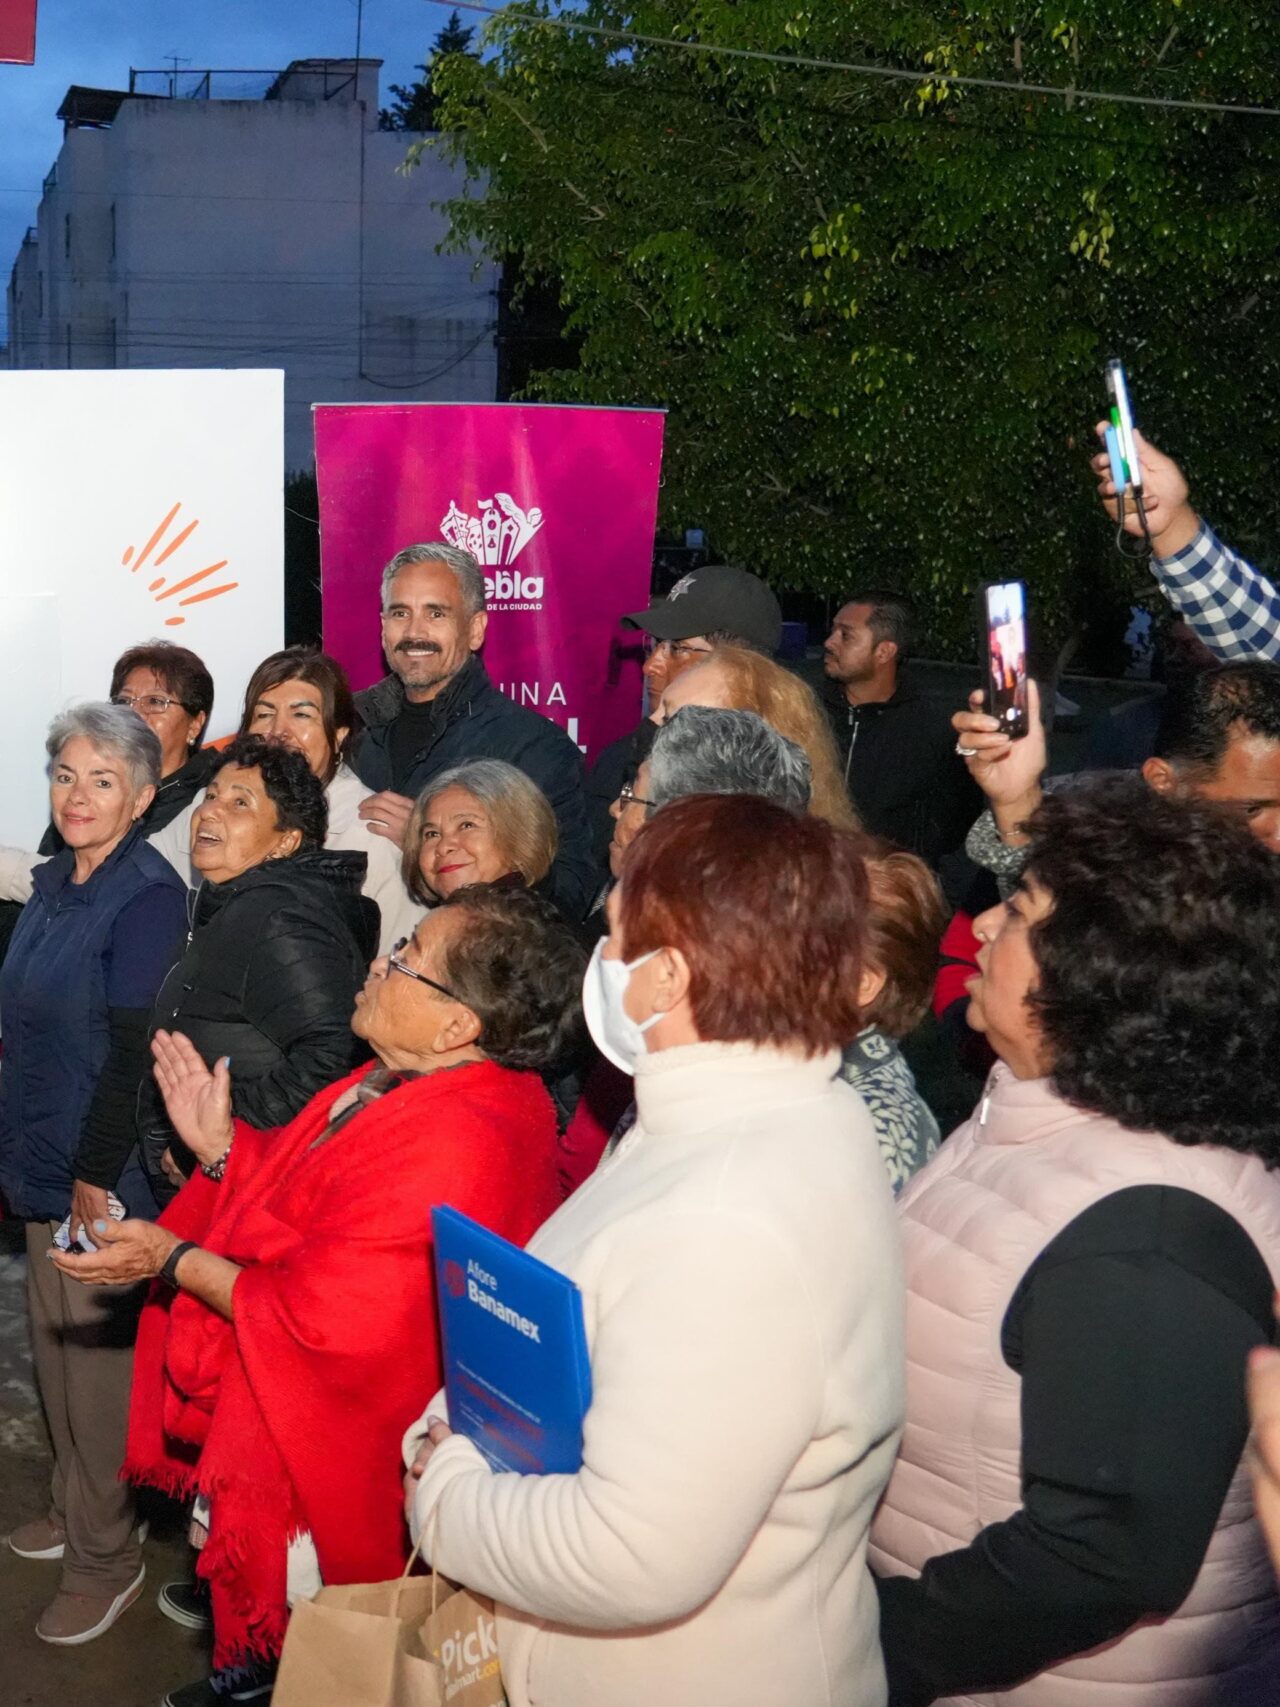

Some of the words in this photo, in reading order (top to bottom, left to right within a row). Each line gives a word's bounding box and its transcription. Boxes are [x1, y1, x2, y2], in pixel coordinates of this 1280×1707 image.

[486, 603, 498, 611] DE
[499, 603, 508, 611] LA
[509, 603, 543, 611] CIUDAD
[467, 1258, 498, 1291] Afore
[467, 1279, 541, 1343] Banamex
